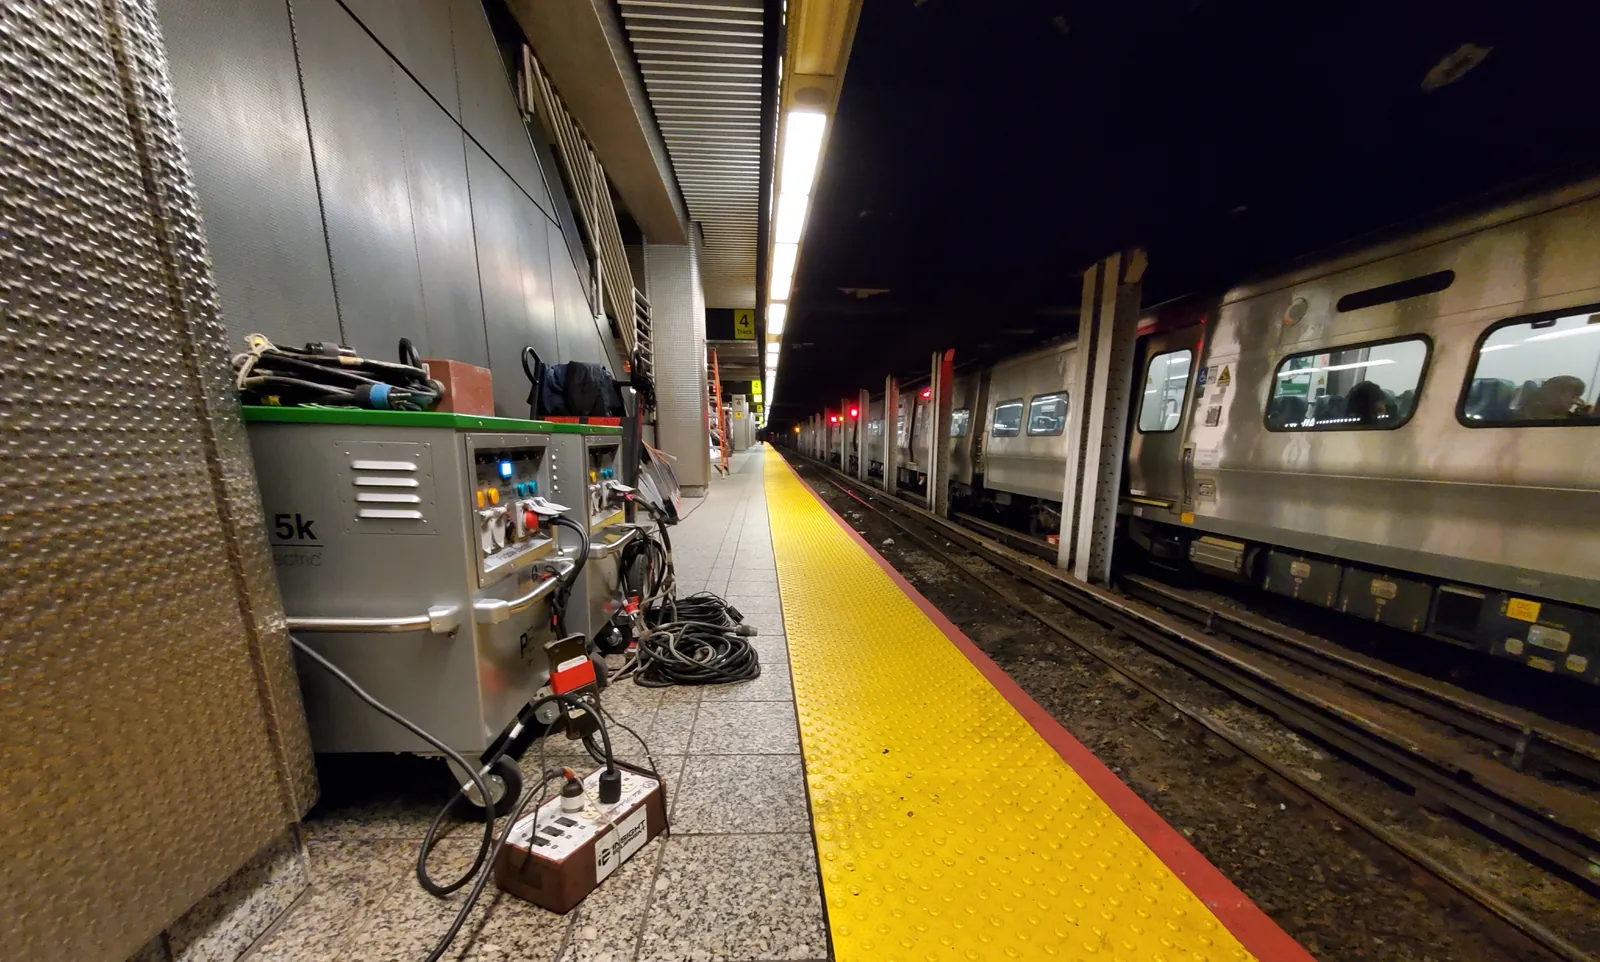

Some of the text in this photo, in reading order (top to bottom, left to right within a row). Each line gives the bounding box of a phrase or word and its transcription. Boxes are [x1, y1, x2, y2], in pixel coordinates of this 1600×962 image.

[739, 314, 749, 328] 4
[275, 513, 318, 540] 5k
[612, 819, 646, 850] INSIGHT
